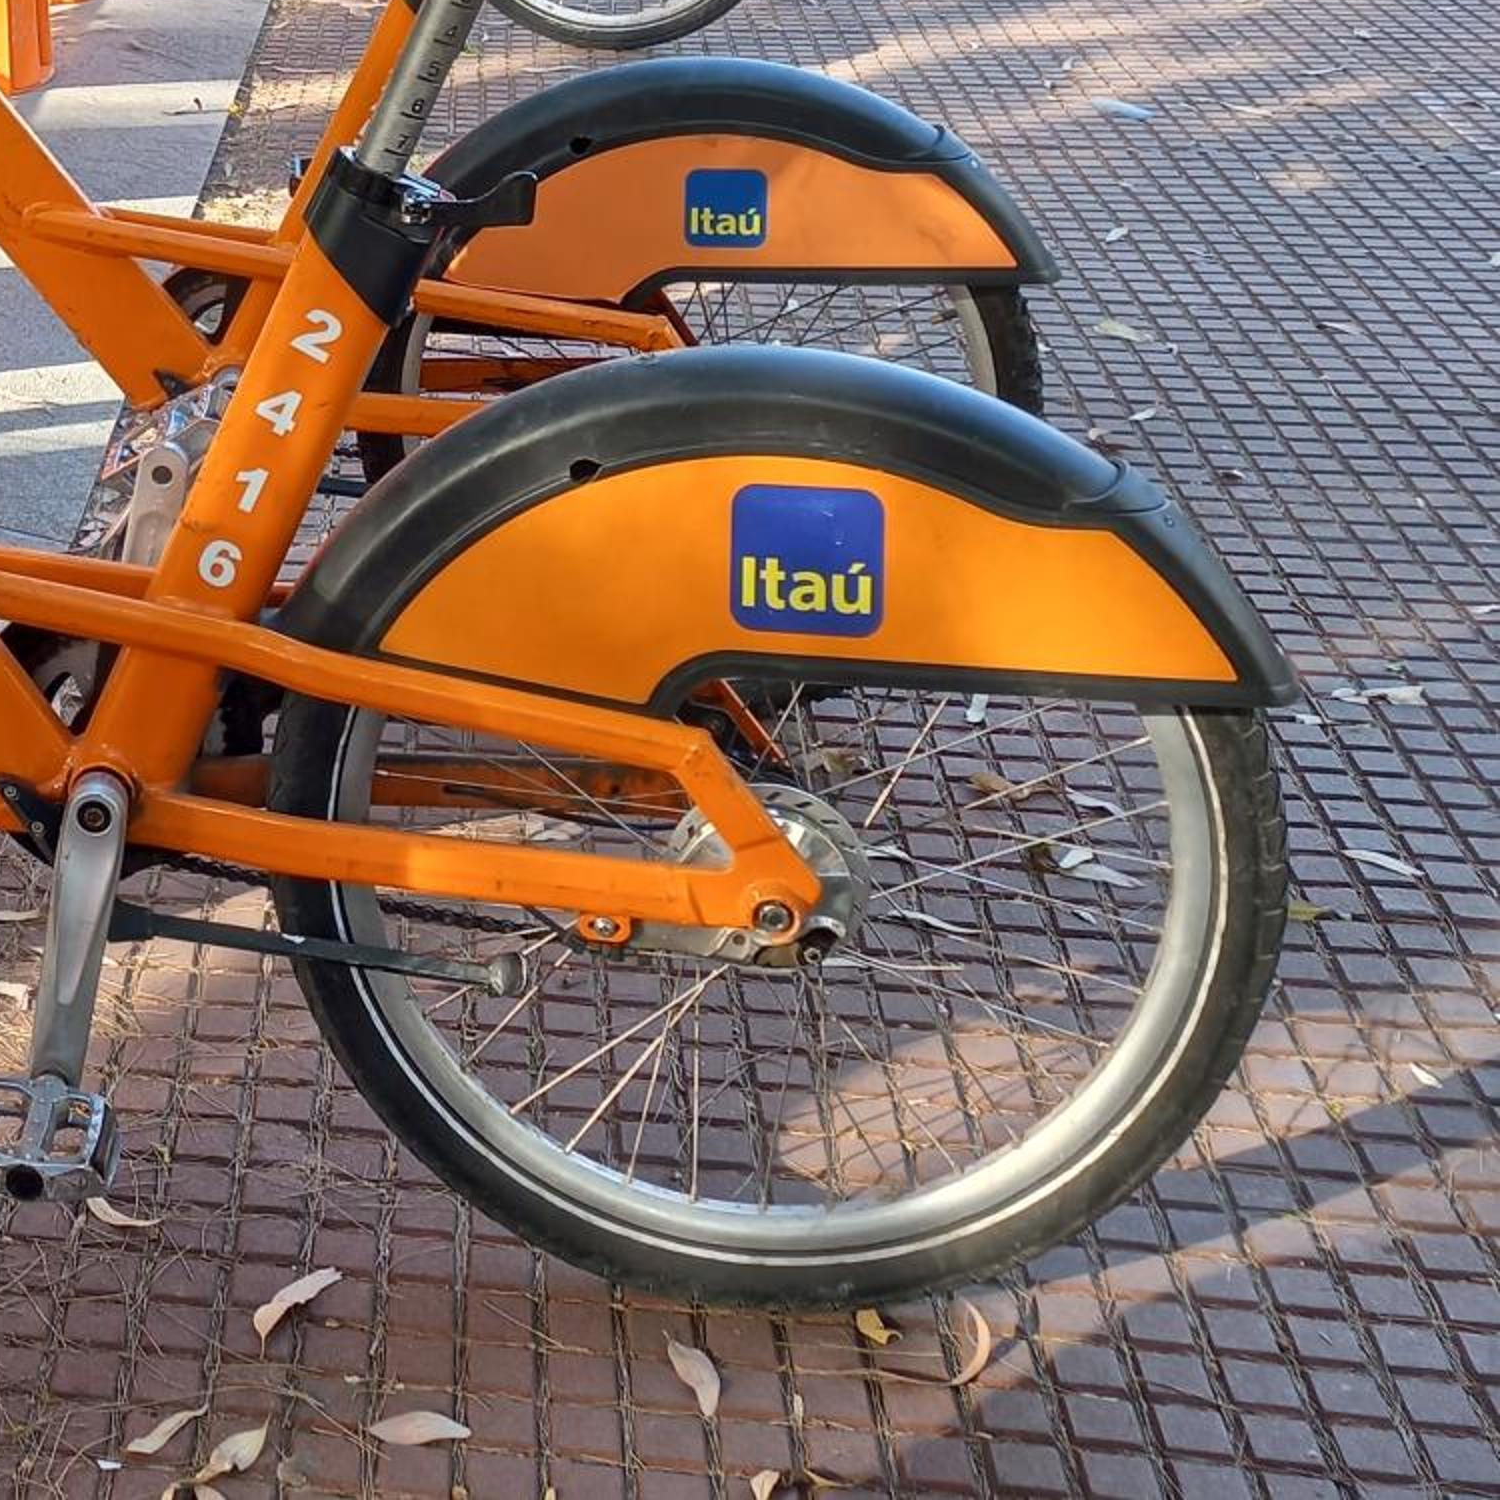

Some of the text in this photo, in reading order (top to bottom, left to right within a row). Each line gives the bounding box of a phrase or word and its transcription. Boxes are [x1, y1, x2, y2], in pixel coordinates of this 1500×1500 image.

[411, 99, 425, 114] 6
[690, 207, 762, 237] Itaú
[740, 555, 872, 616] Itaú
